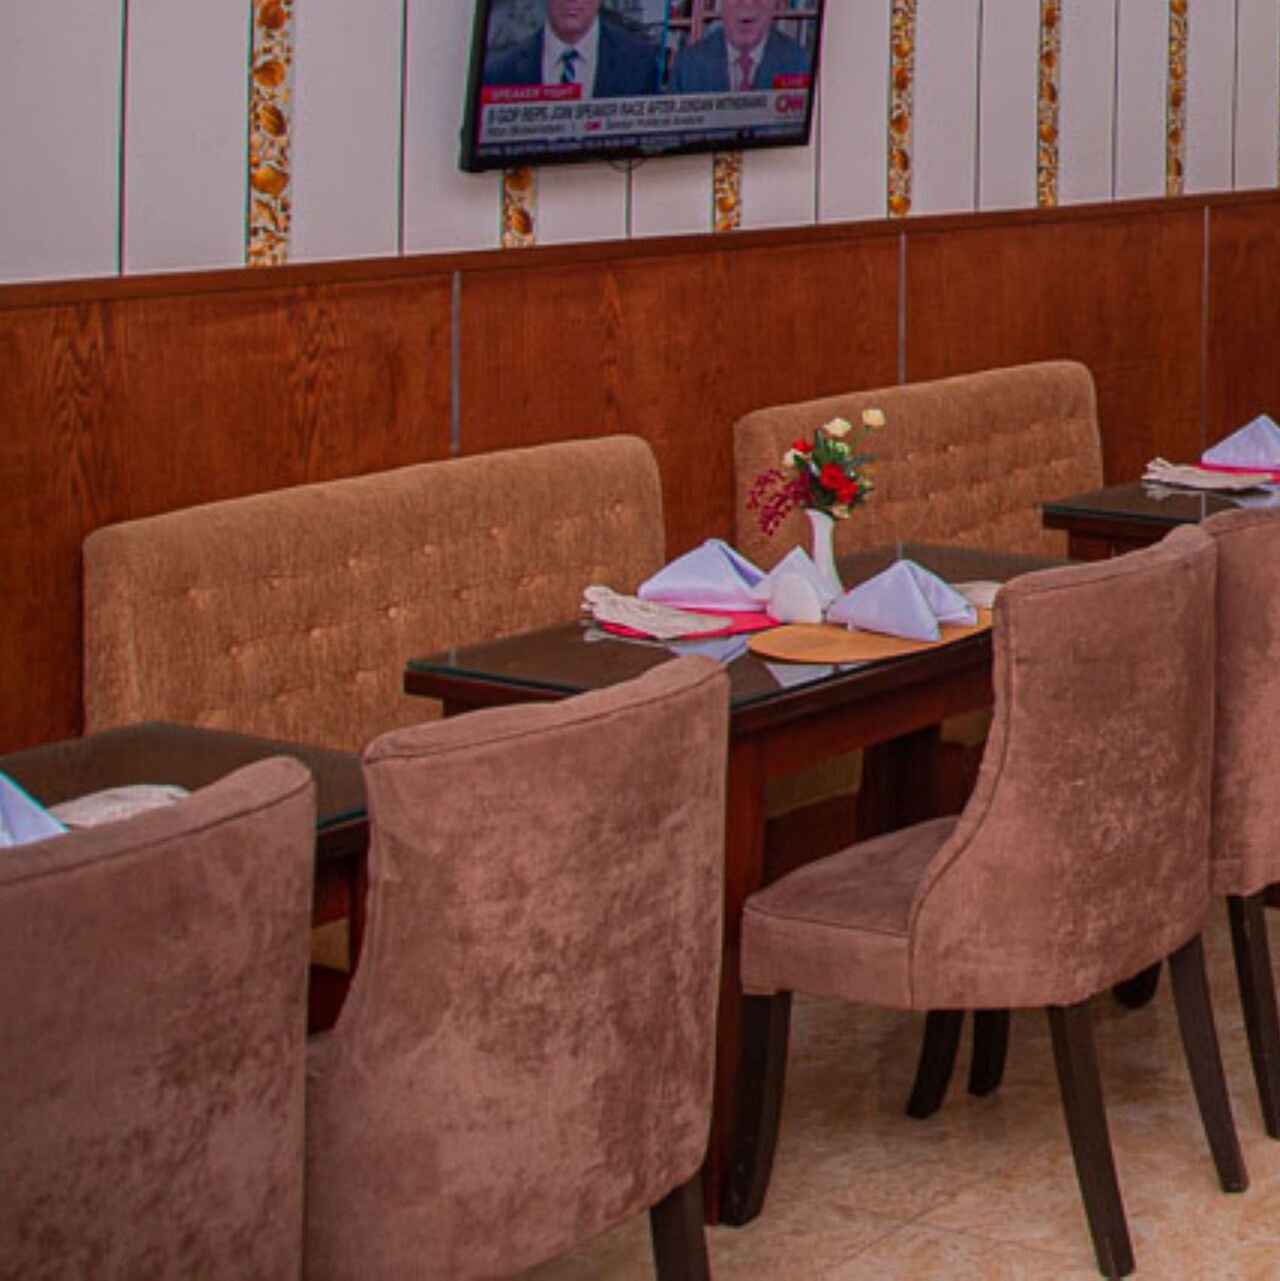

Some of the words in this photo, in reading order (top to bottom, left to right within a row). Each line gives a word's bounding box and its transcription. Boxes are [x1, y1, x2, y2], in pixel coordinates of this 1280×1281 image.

[551, 105, 573, 120] JOIN
[576, 102, 617, 119] SPEAKER
[620, 101, 645, 116] RACE
[648, 98, 675, 114] AFTER
[775, 93, 804, 113] CNN
